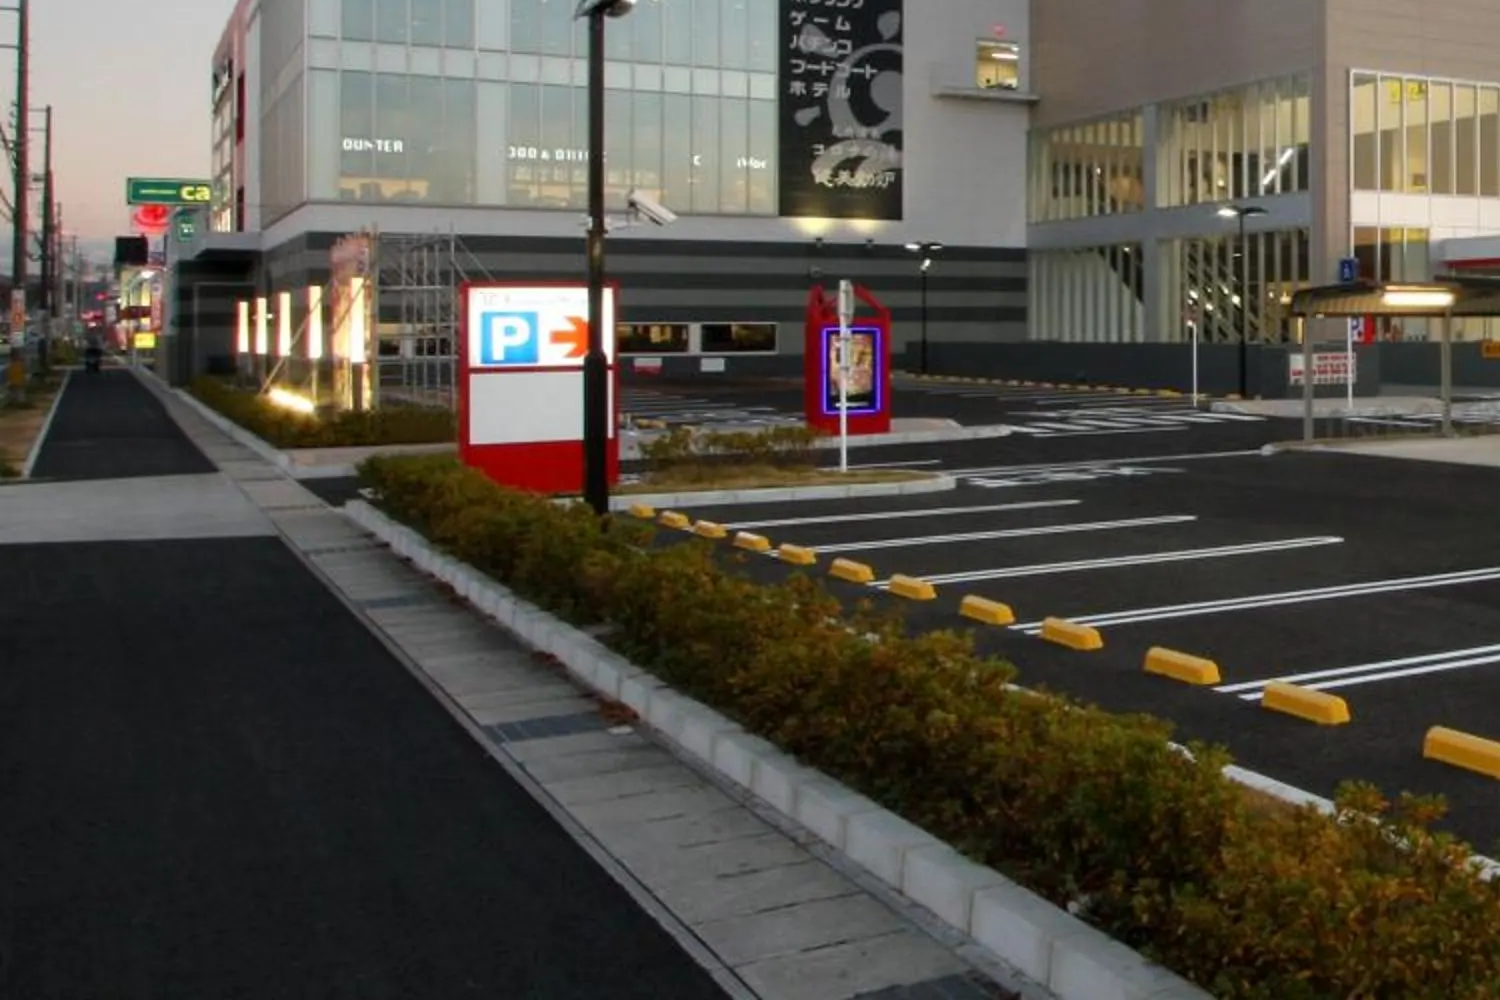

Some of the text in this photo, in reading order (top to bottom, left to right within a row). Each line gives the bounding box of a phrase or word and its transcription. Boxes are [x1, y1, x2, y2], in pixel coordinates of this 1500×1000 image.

[790, 10, 851, 31] ゲーム
[790, 59, 878, 79] フードコート
[789, 81, 851, 100] ホテル
[491, 315, 531, 361] P
